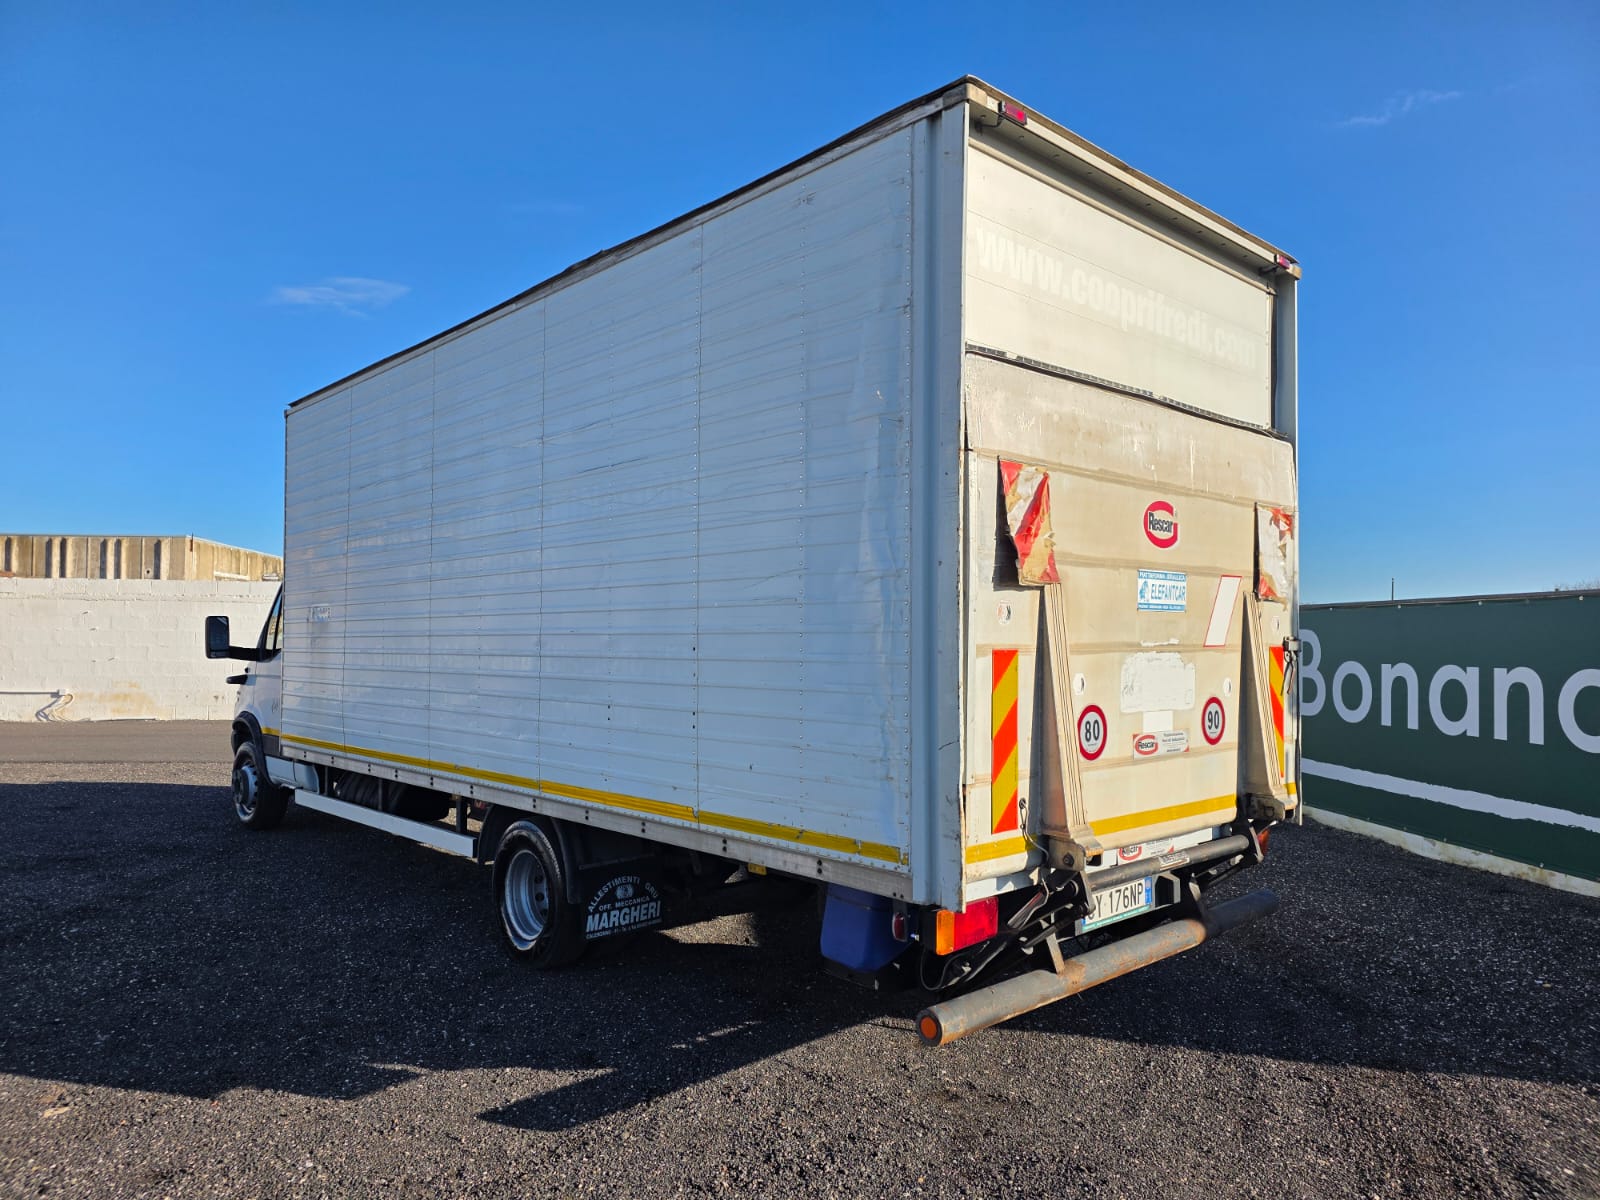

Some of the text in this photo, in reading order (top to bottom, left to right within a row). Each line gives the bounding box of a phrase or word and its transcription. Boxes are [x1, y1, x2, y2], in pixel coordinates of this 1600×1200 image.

[1148, 511, 1174, 534] Rescar
[1151, 583, 1186, 601] ELEFANTCAR
[1085, 719, 1100, 743] 80
[1207, 710, 1220, 730] 90
[1137, 740, 1156, 750] Rescar
[588, 875, 641, 913] ALLESTIMENTI
[615, 895, 650, 908] MECCANICA
[1109, 883, 1144, 914] 176NP
[585, 900, 662, 933] MARGHERI
